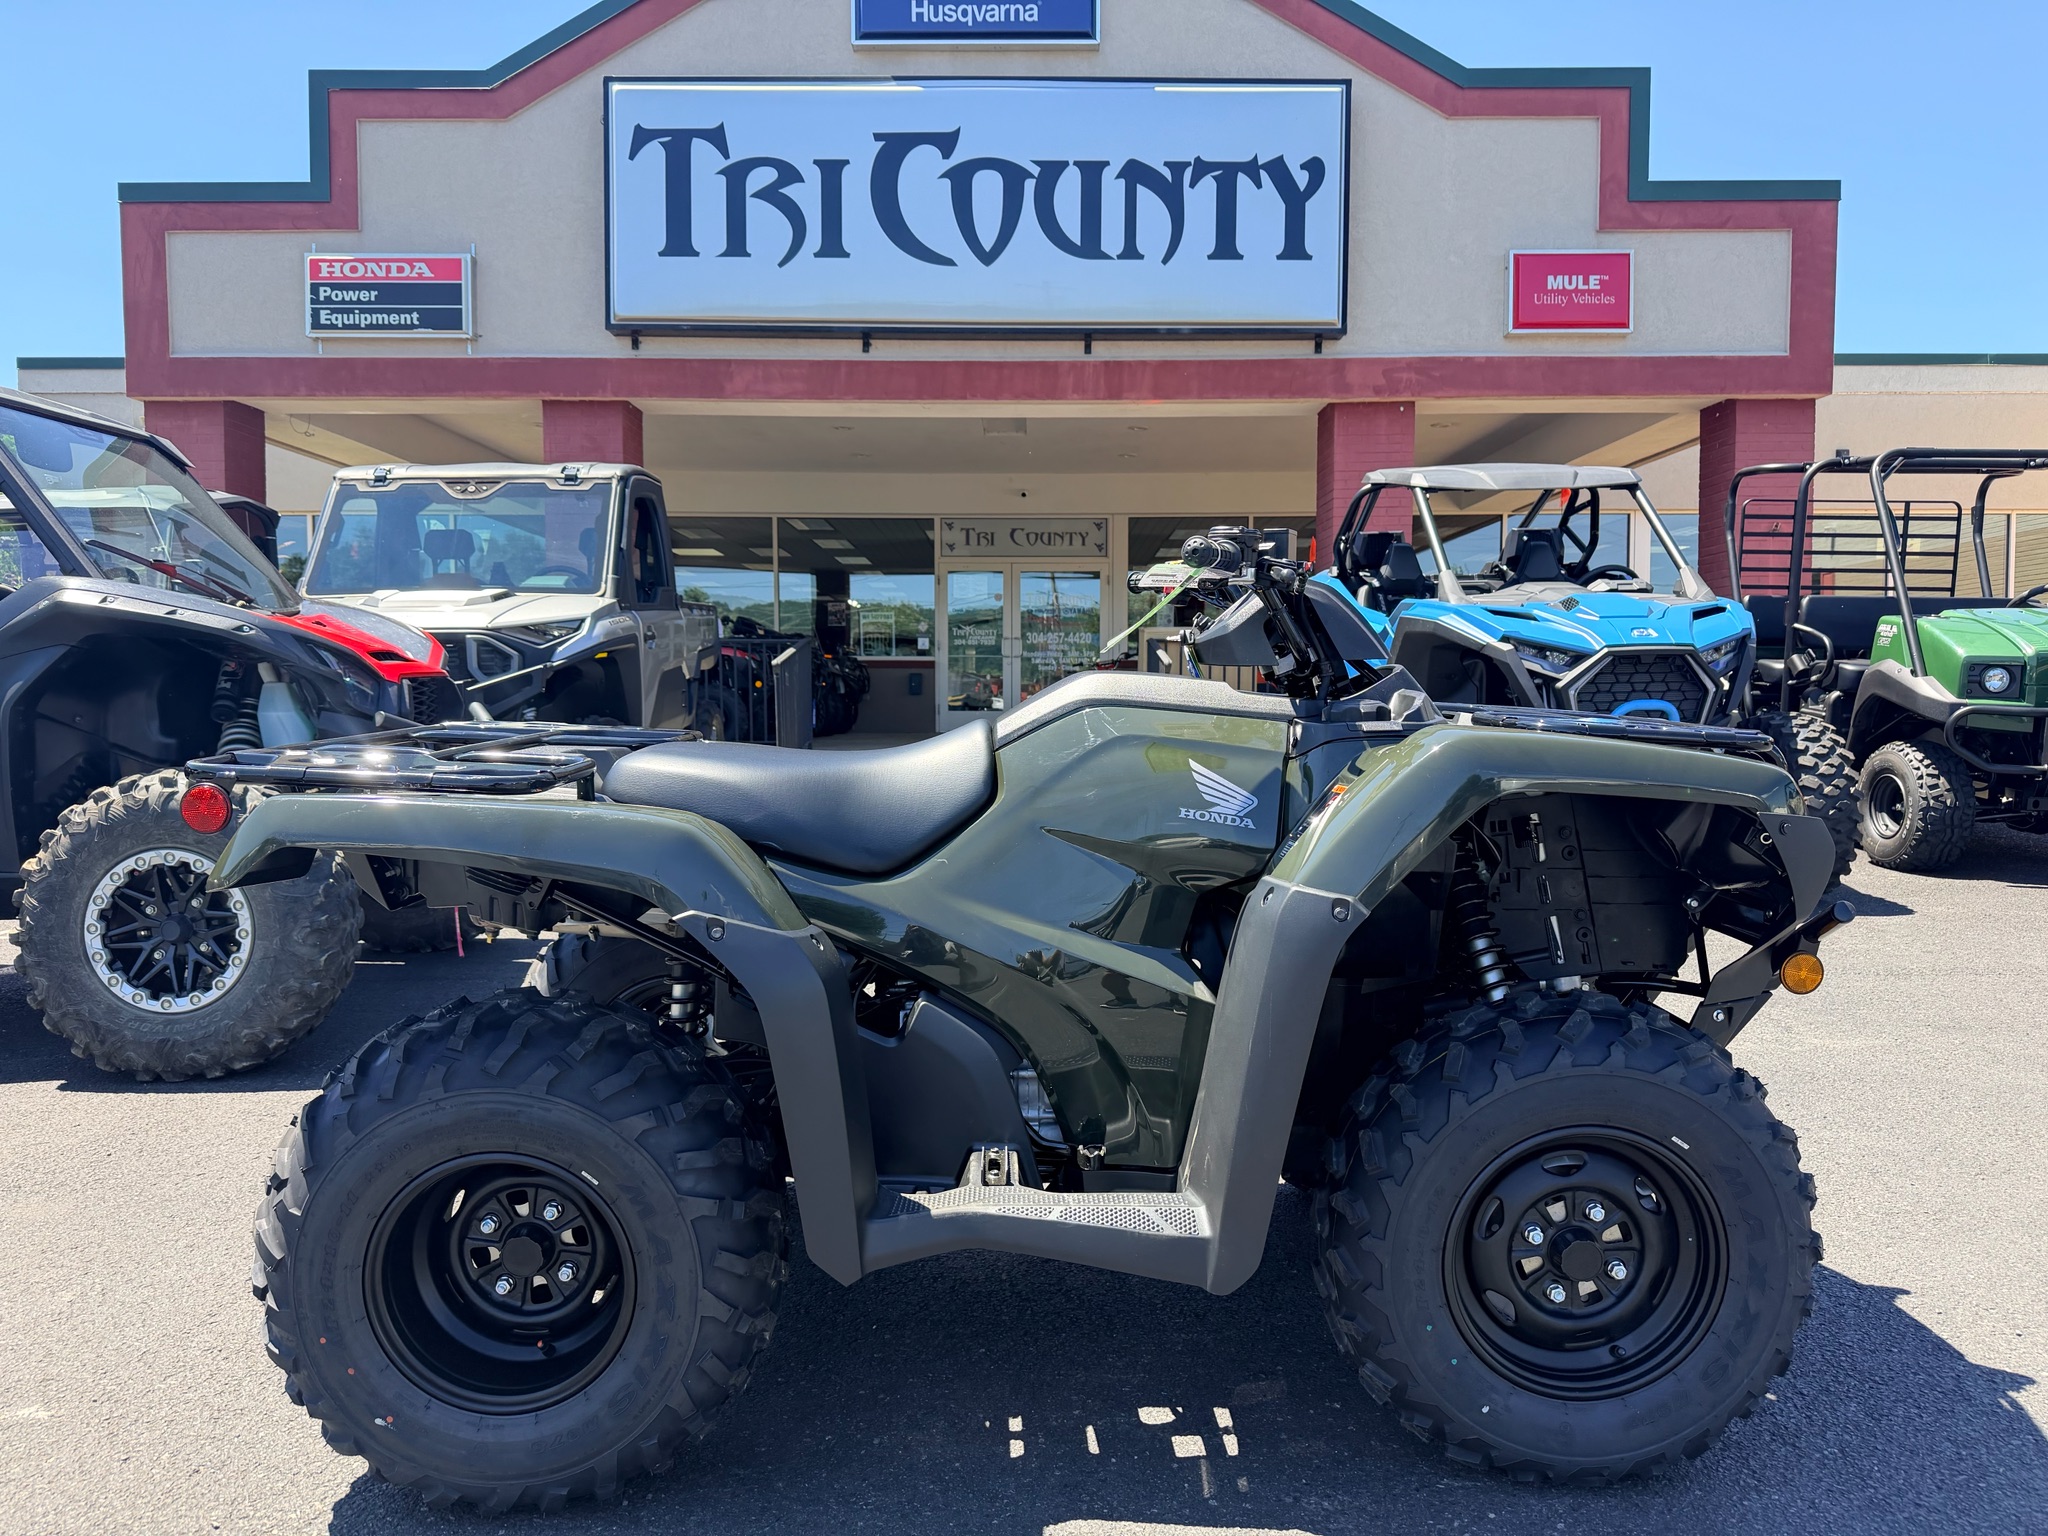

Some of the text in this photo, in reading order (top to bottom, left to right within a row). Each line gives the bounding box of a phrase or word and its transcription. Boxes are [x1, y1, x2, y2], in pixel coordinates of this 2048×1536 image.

[911, 0, 1039, 26] Husqvarna
[318, 262, 435, 277] HONDA
[319, 286, 378, 301] Power
[1534, 293, 1616, 307] Utility Vehicles
[319, 309, 420, 328] Equipment
[960, 527, 1089, 548] TRI COUNTY
[1026, 632, 1092, 644] 304-257-4420
[1178, 807, 1257, 830] HONDA
[1698, 1161, 1769, 1393] MAXXIS
[604, 1182, 676, 1414] MAXXIS
